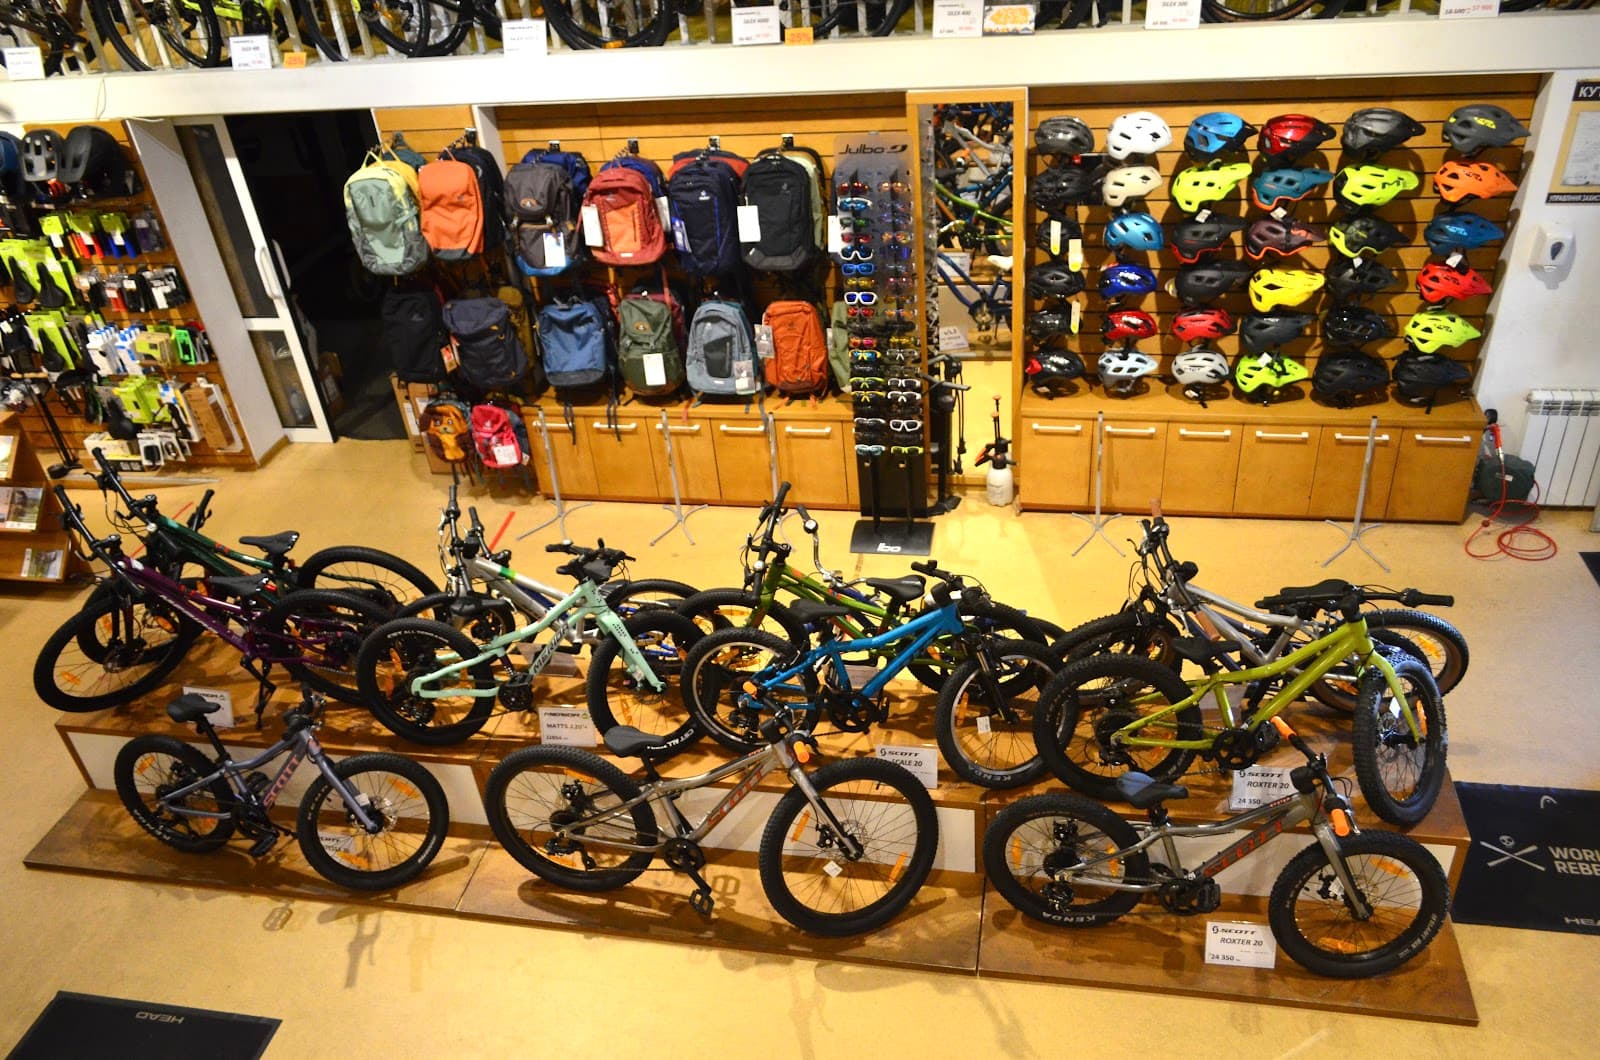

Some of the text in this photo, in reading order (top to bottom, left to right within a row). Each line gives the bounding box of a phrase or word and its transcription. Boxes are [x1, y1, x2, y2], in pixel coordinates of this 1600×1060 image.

[838, 143, 885, 155] Julbo
[1247, 781, 1278, 789] ROXTER
[1042, 911, 1096, 923] KENDA
[1220, 937, 1252, 946] ROXTER
[135, 1010, 184, 1024] HEAD
